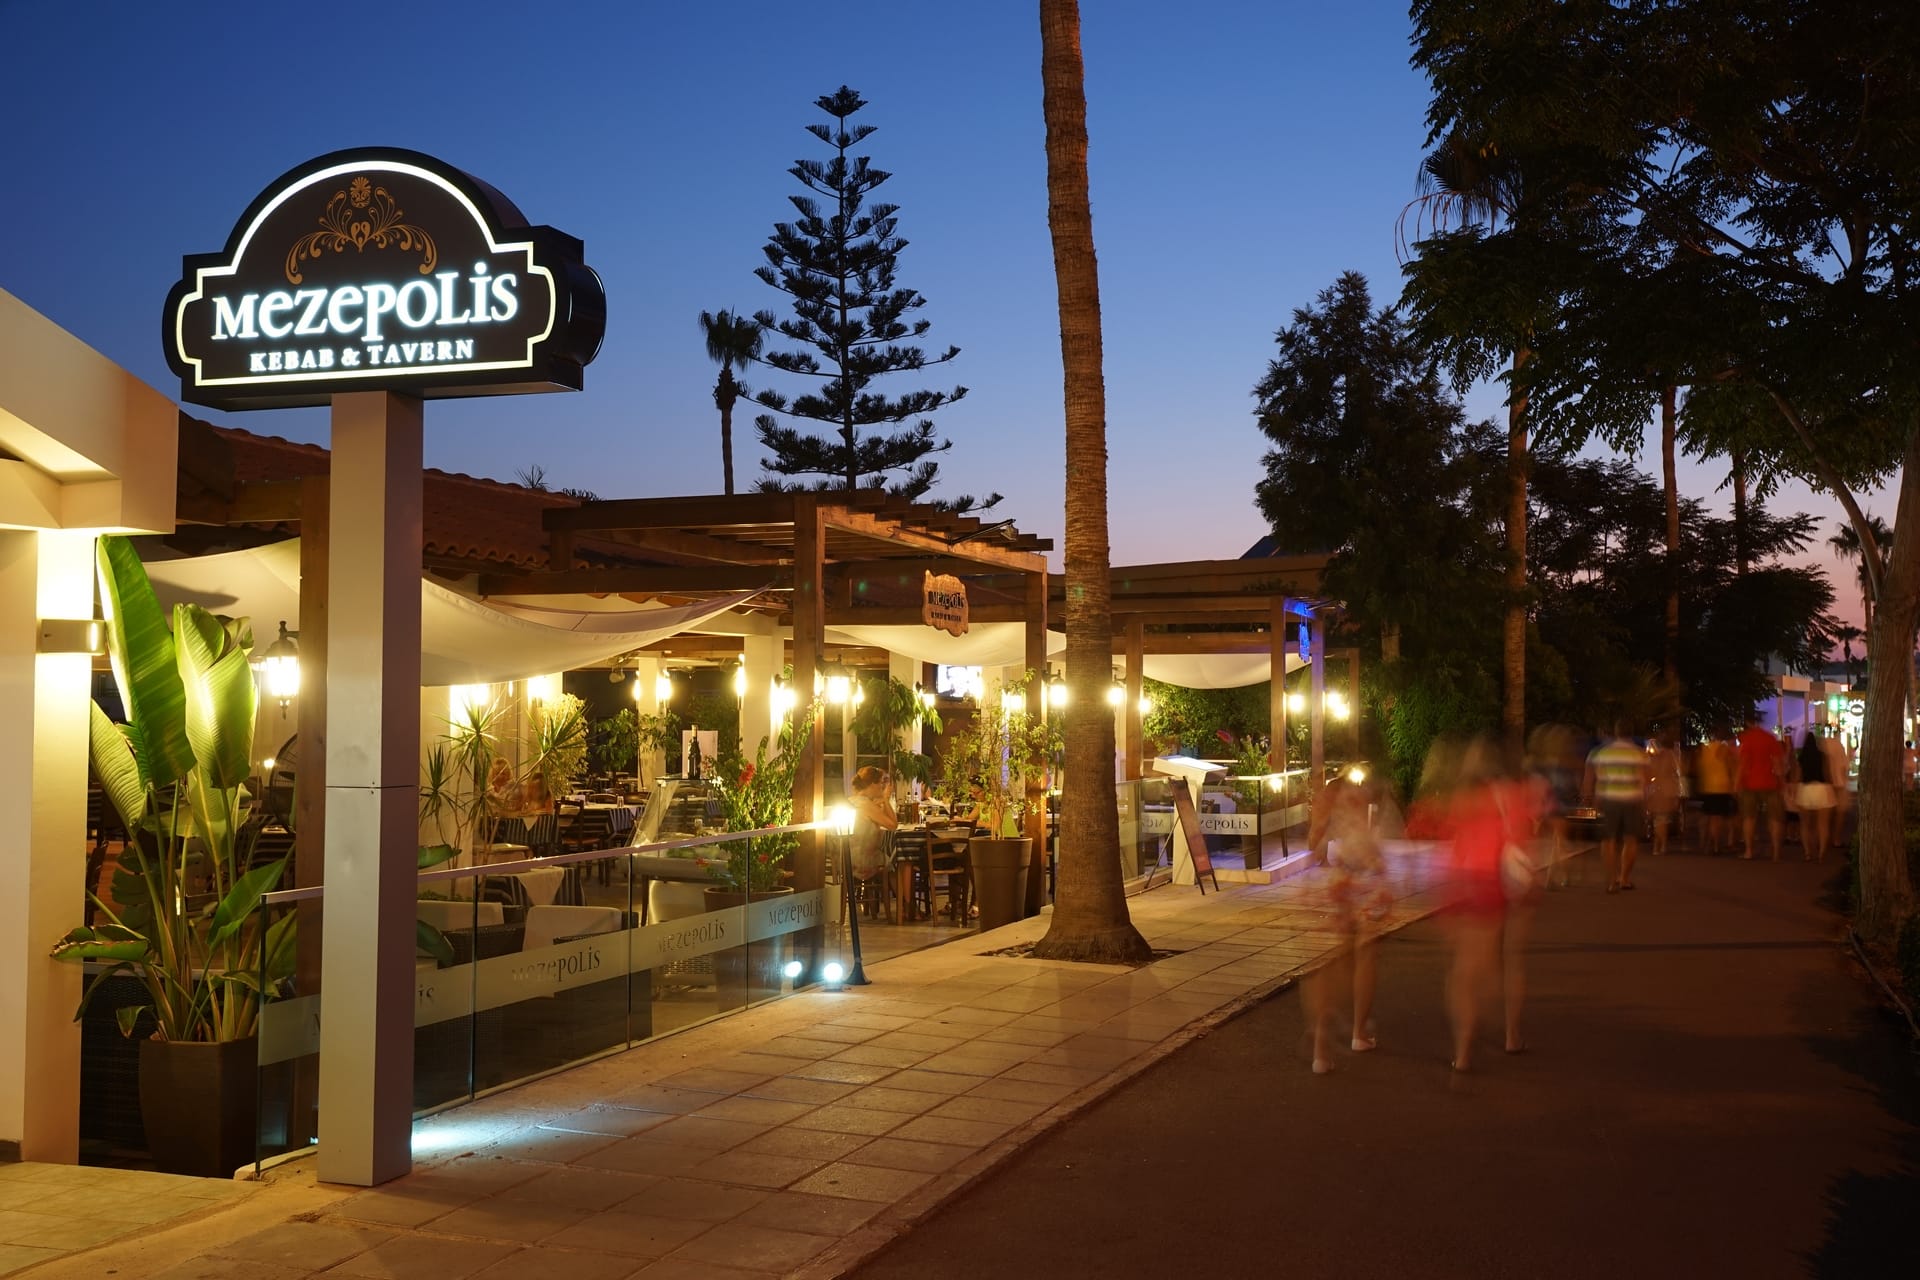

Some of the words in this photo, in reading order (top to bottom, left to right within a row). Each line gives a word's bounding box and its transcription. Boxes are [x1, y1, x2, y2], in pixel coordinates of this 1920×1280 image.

[249, 349, 335, 372] KEBAB
[341, 347, 361, 367] &
[367, 339, 475, 364] TAVERN
